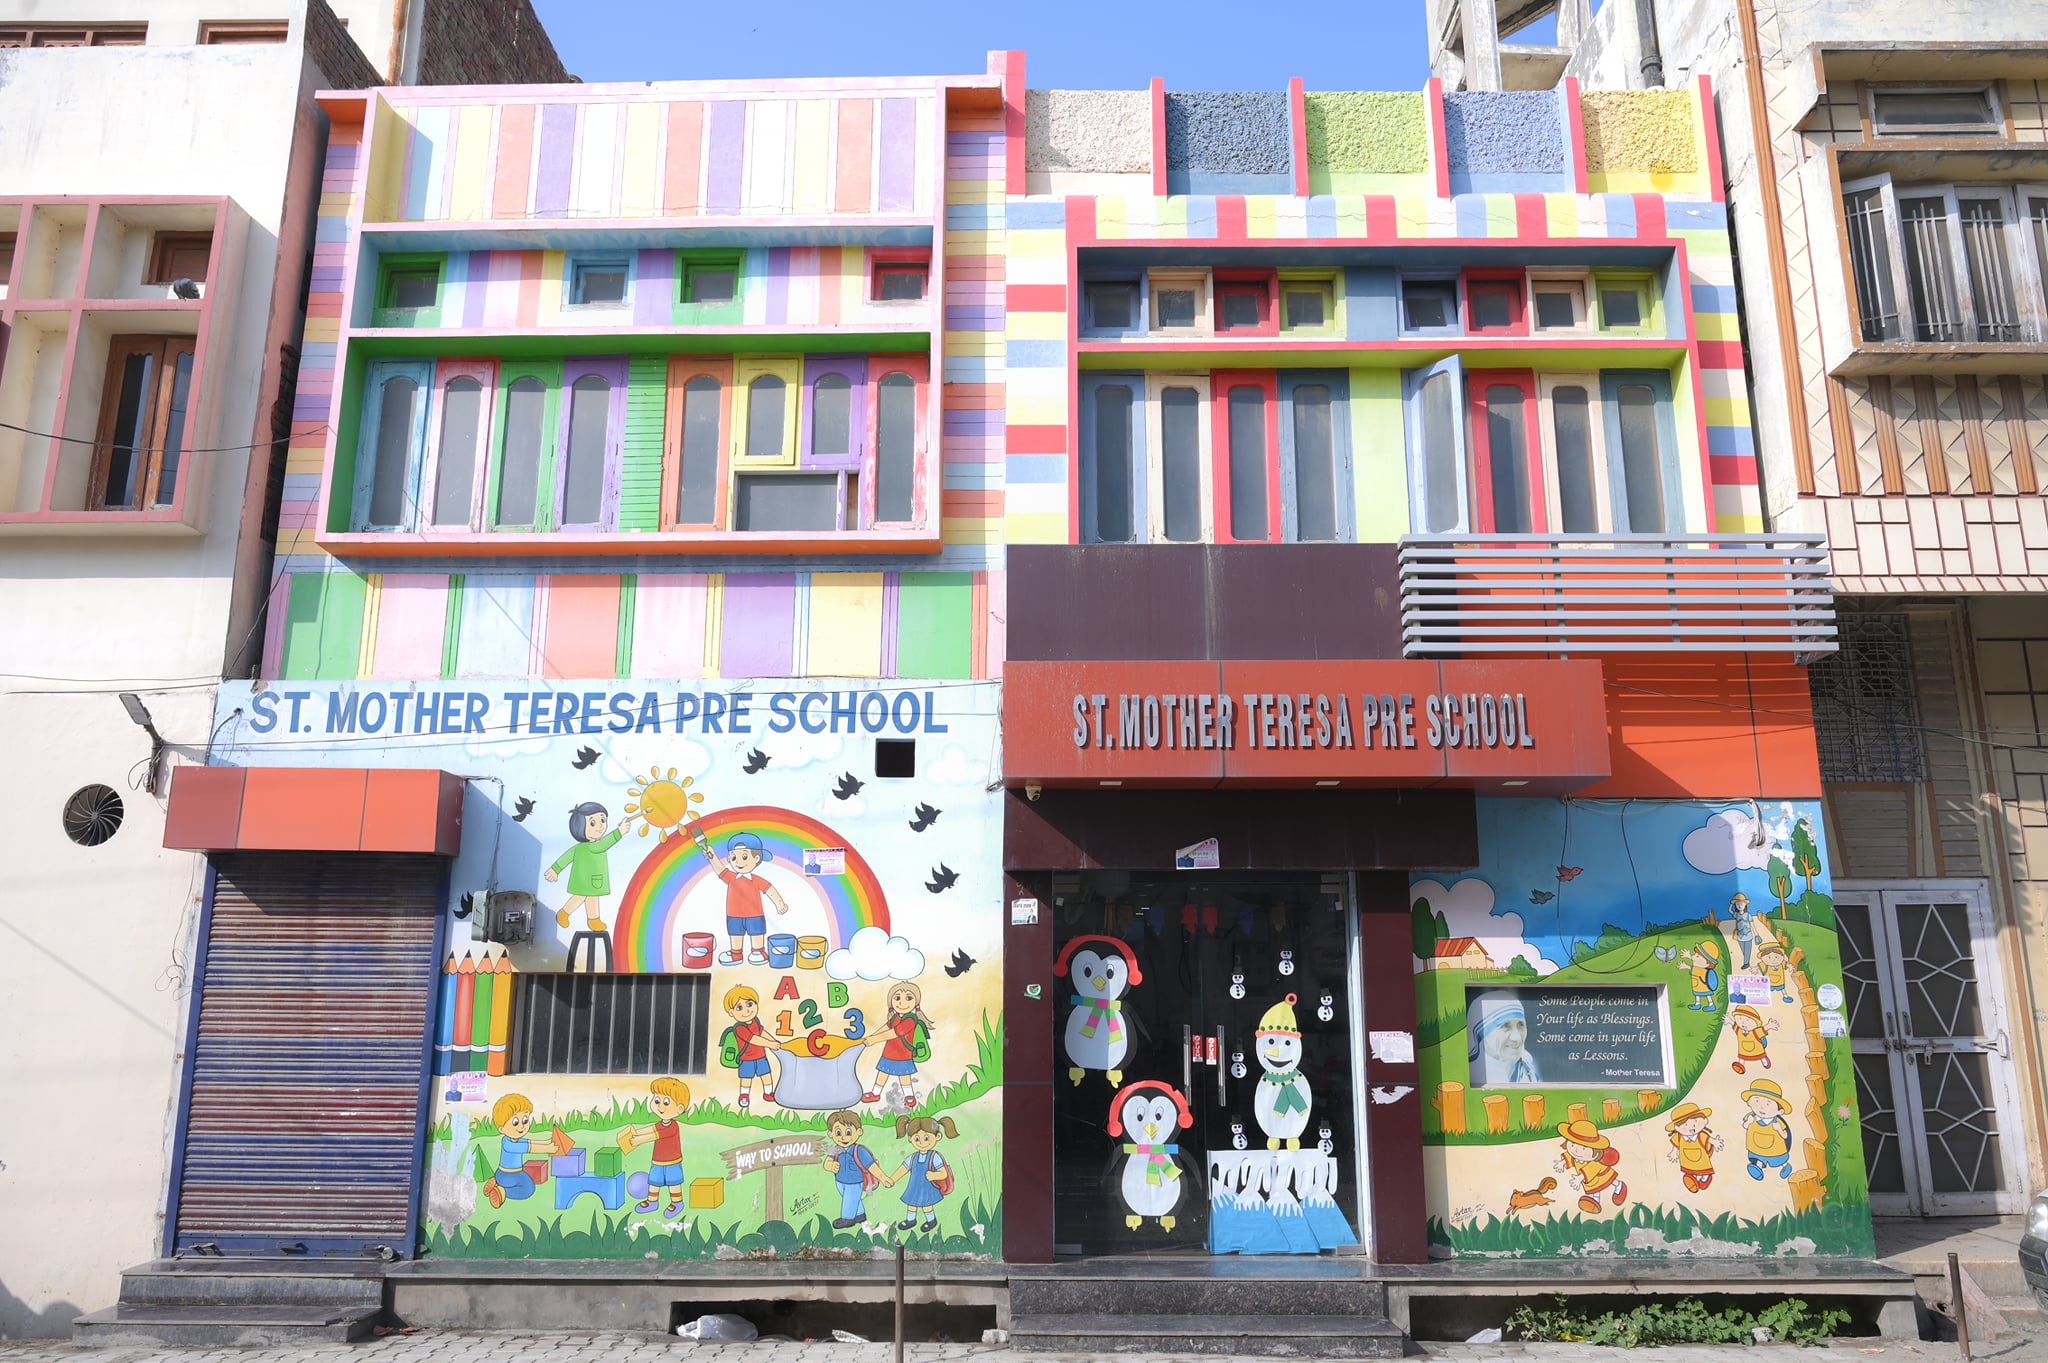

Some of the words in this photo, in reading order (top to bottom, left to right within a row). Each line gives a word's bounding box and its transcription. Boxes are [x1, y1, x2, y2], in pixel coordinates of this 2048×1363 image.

[250, 691, 312, 733] ST.
[325, 691, 490, 734] MOTHER
[503, 692, 661, 734] TERESA
[675, 692, 752, 733] PRE
[769, 691, 948, 734] SCHOOL
[1073, 694, 1113, 747] ST.
[1119, 694, 1233, 748] MOTHER
[1243, 694, 1352, 748] TERESA
[1362, 694, 1415, 747] PRE
[1426, 693, 1533, 747] SCHOOL
[773, 976, 800, 1000] A
[827, 982, 849, 1008] B
[1539, 995, 1568, 1007] Some
[1570, 995, 1606, 1010] People
[1608, 997, 1635, 1007] come
[1637, 995, 1648, 1006] in
[776, 1010, 794, 1036] 1
[798, 999, 823, 1029] 2
[844, 1008, 865, 1040] 3
[1536, 1013, 1564, 1026] Your
[1566, 1013, 1585, 1026] life
[1587, 1016, 1599, 1024] as
[1601, 1013, 1654, 1029] Blessings.
[807, 1029, 830, 1056] C
[1537, 1032, 1567, 1043] Some
[1568, 1033, 1596, 1043] come
[1598, 1031, 1609, 1042] in
[1611, 1033, 1636, 1046] your
[1638, 1031, 1656, 1046] life
[1568, 1052, 1580, 1061] as
[1582, 1050, 1628, 1061] Lessons.
[736, 1151, 756, 1168] WAY
[759, 1148, 771, 1162] TO
[773, 1142, 814, 1159] SCHOOL
